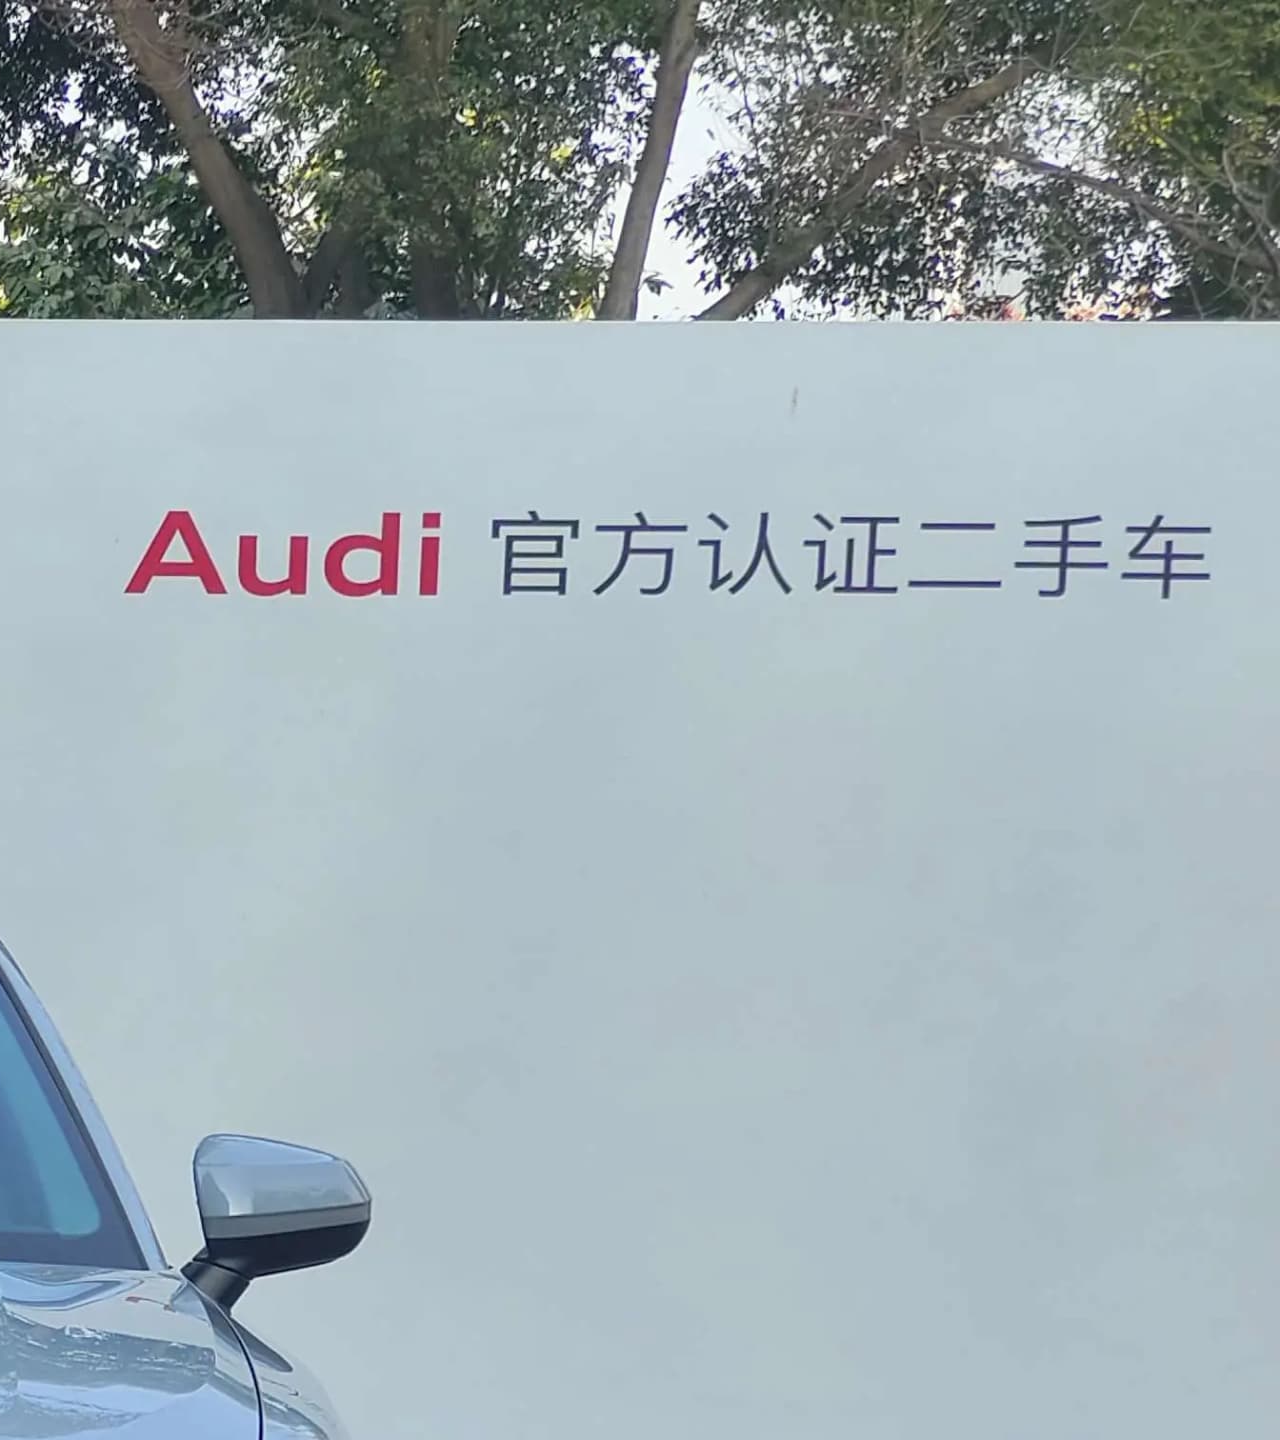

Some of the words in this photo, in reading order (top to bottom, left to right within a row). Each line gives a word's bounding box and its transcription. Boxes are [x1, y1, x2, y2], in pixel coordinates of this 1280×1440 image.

[124, 510, 441, 597] Audi
[491, 510, 1212, 599] 官方认证二手车
